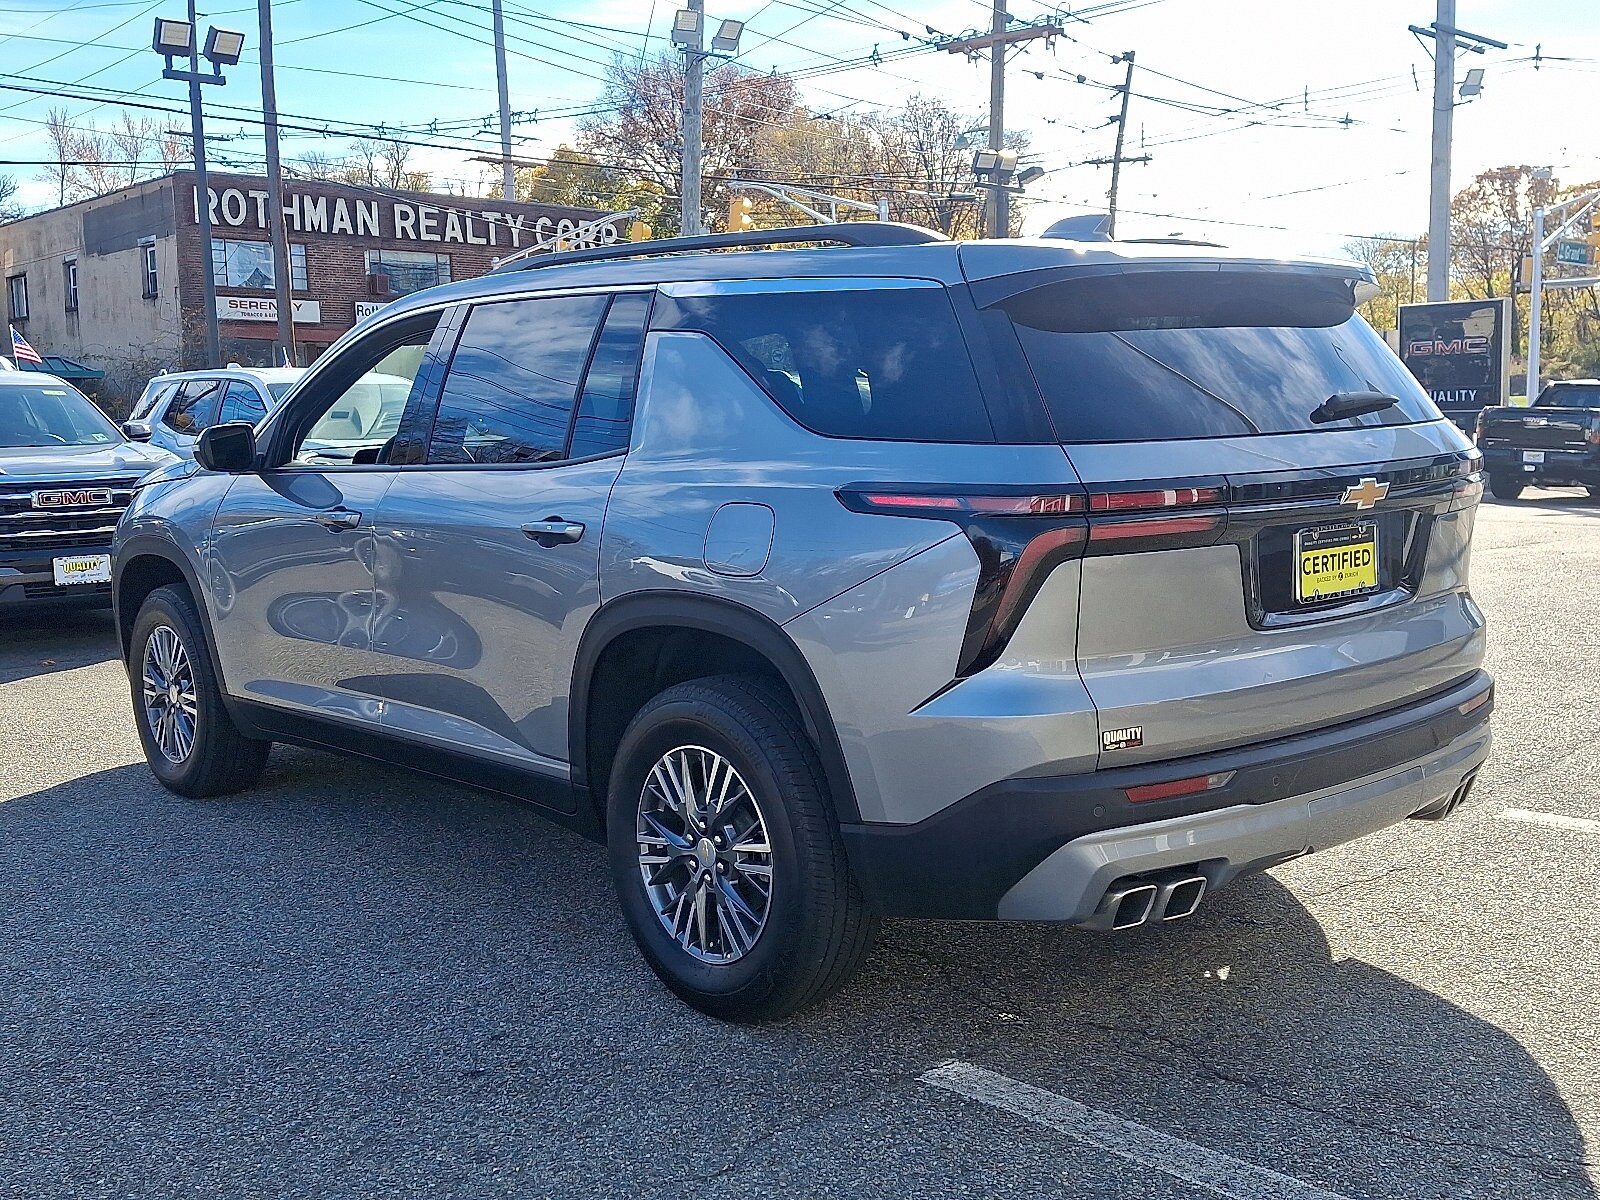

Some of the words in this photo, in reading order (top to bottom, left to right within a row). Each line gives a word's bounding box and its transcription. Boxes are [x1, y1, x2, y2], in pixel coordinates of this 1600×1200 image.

[193, 185, 380, 237] ROTHMAN
[393, 203, 525, 248] REALTY
[228, 299, 302, 311] SERENY
[1409, 337, 1488, 356] GMC
[1427, 389, 1478, 402] UALITY
[38, 490, 109, 506] GMC
[63, 559, 101, 574] QUALITY
[1302, 548, 1371, 576] CERTIFIED
[1103, 726, 1142, 746] QUALITY
